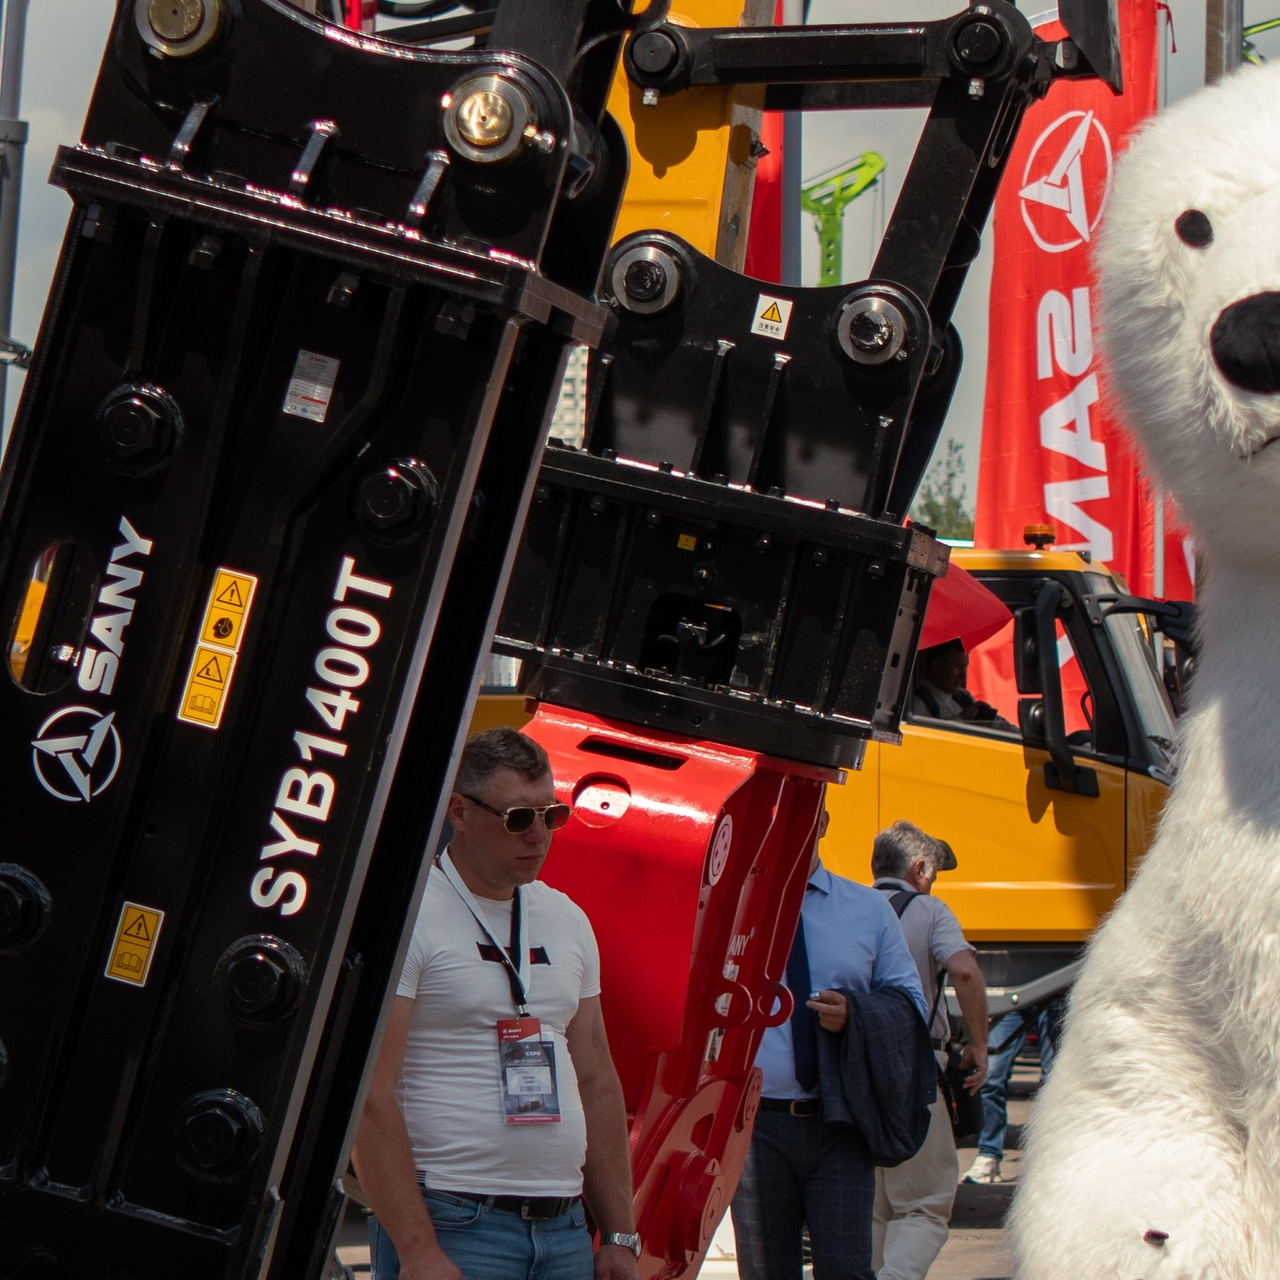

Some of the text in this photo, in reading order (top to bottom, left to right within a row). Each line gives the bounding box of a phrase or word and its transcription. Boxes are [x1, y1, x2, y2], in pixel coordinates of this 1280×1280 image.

[78, 516, 154, 696] SANY
[250, 556, 393, 916] SYB1400T
[729, 933, 750, 957] ANY
